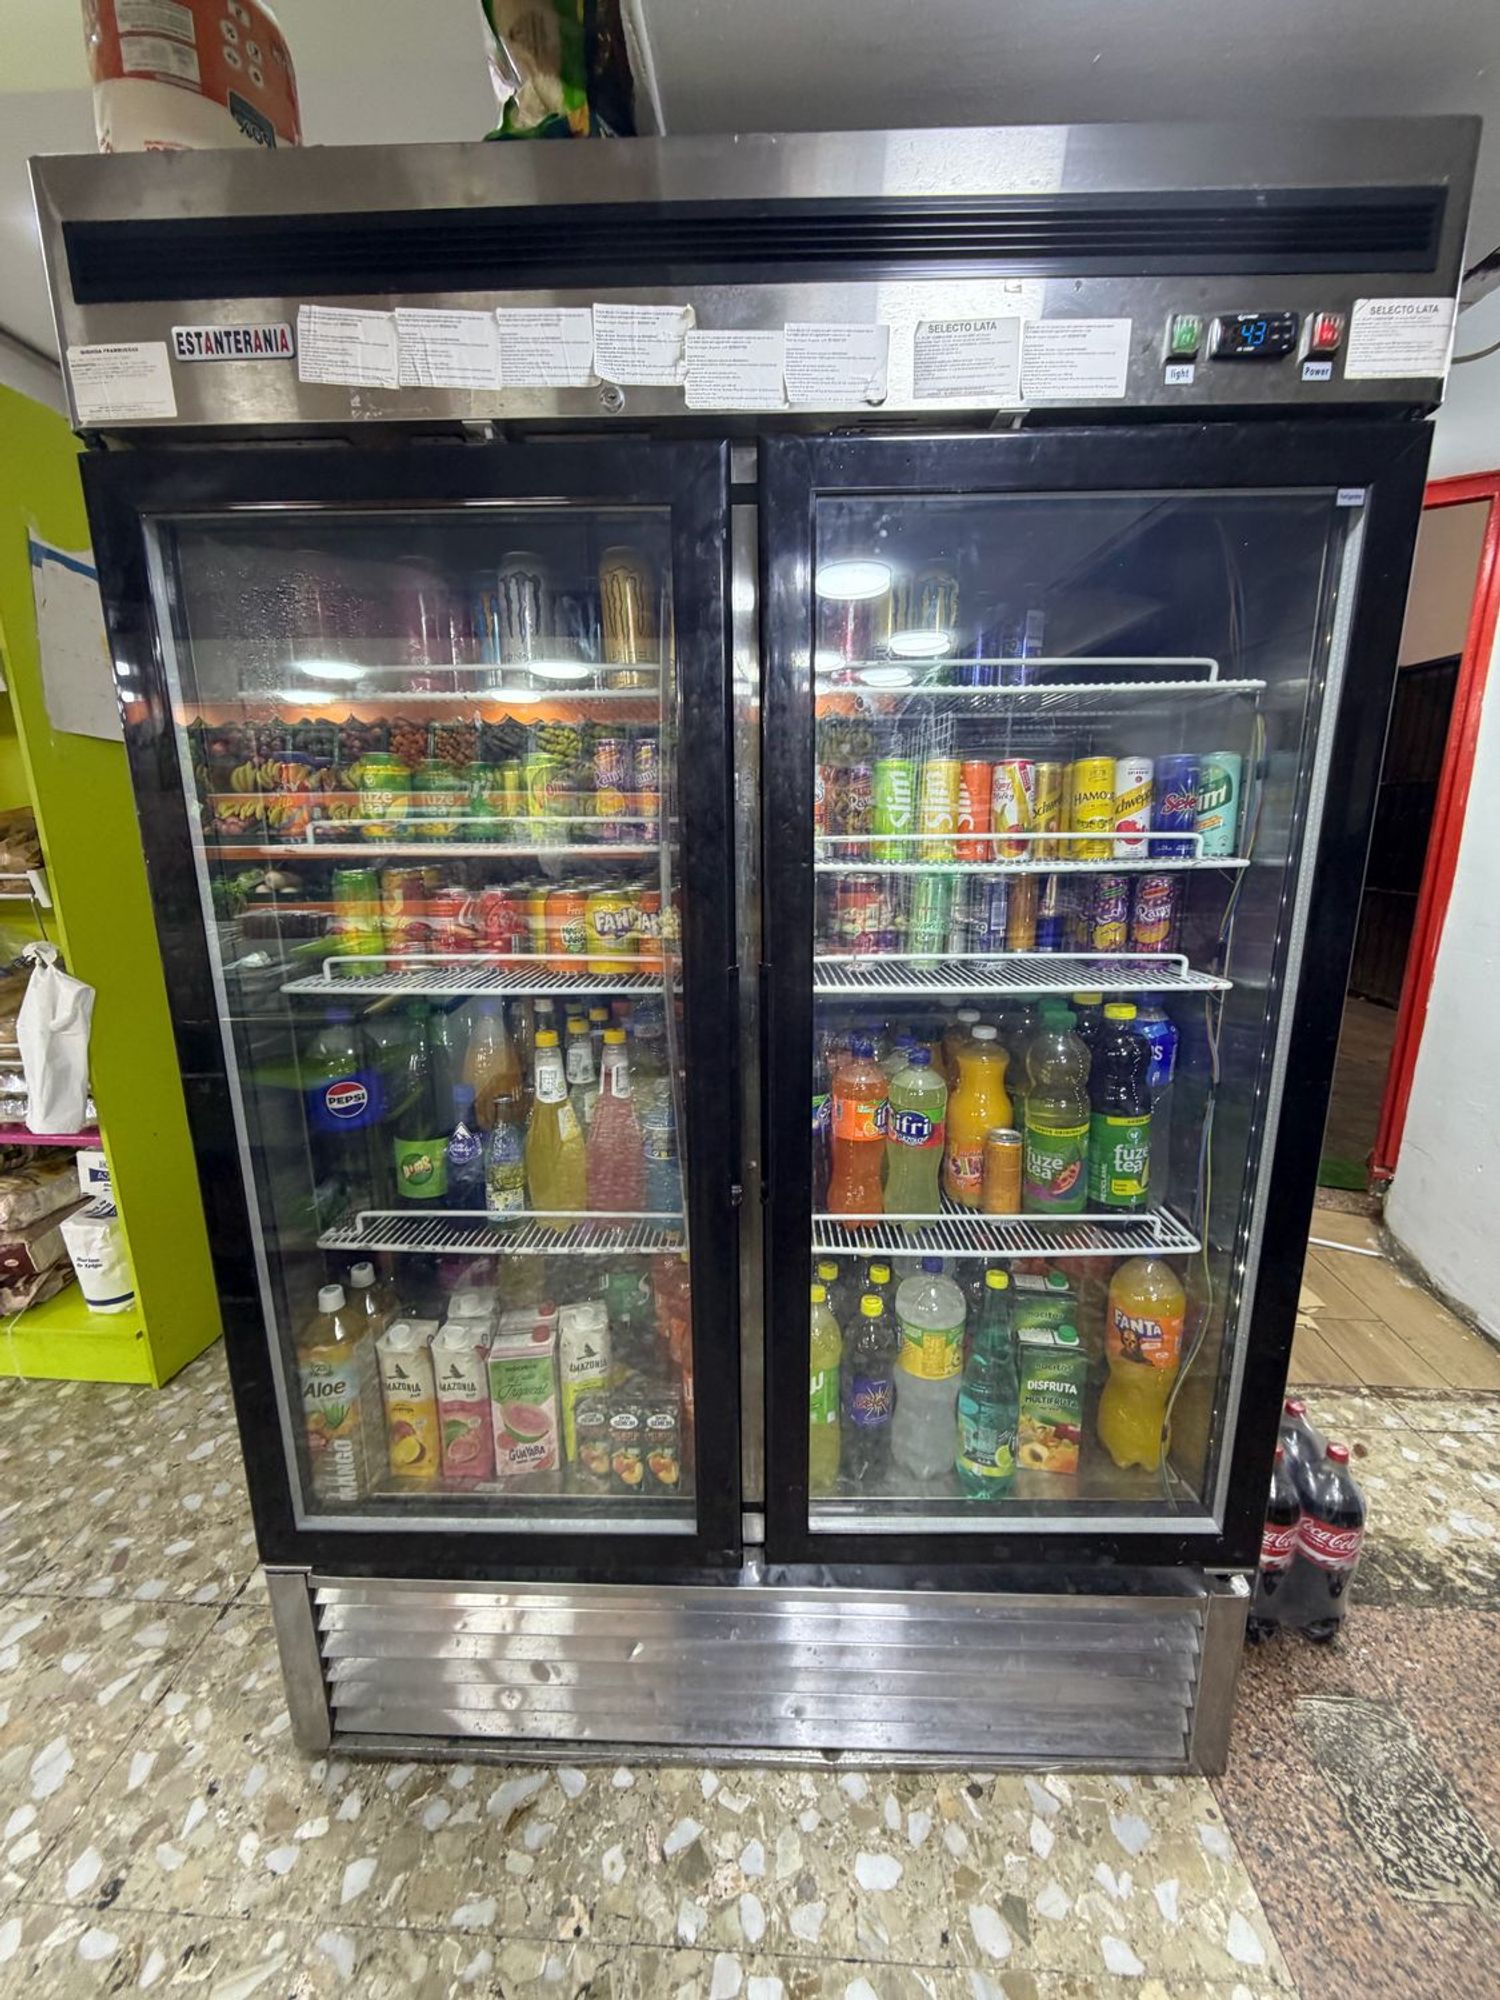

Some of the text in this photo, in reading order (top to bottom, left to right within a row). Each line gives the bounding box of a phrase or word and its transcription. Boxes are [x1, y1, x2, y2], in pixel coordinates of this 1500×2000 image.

[1370, 304, 1440, 316] SELECTO LATA
[928, 321, 997, 334] SELECTO LATA
[1241, 322, 1267, 346] 43
[175, 329, 290, 355] ESTANTERANIA
[1170, 367, 1190, 380] light
[1304, 364, 1330, 377] Power
[326, 1092, 368, 1107] PEPSI
[896, 1114, 930, 1136] ifri
[1113, 1159, 1143, 1174] tea
[1114, 1307, 1162, 1337] FANTA
[303, 1381, 346, 1398] Aloe
[1026, 1380, 1078, 1396] DISFRUTA
[509, 1445, 546, 1462] GUAYABA
[333, 1439, 358, 1501] MANGO
